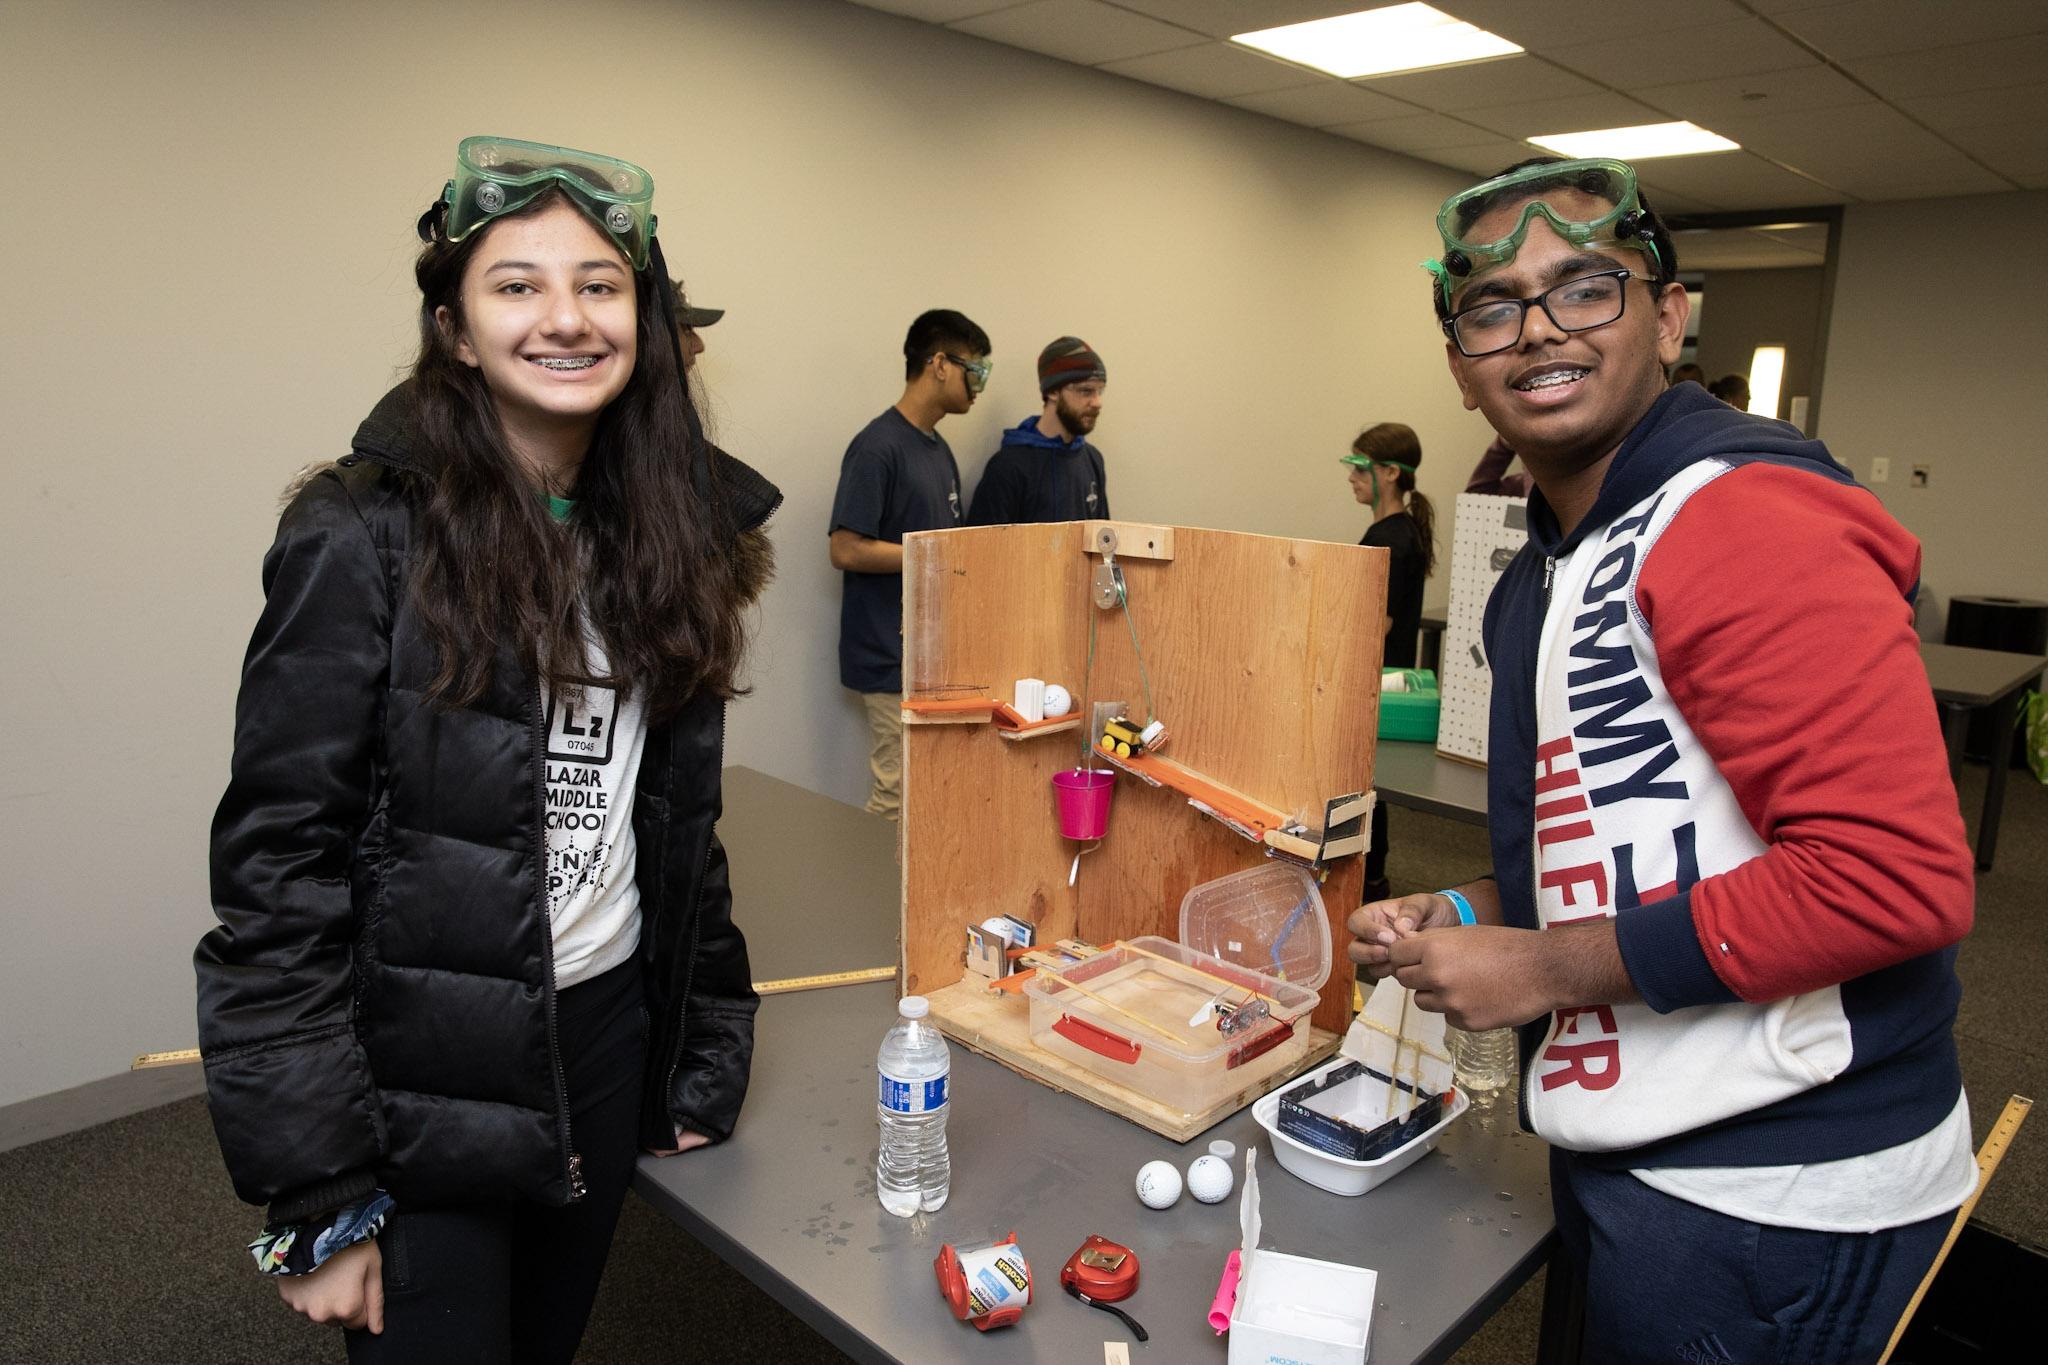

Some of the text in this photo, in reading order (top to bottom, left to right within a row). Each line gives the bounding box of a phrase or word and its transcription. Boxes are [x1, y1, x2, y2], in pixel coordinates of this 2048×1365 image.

[1567, 490, 1689, 808] TOMMY
[567, 740, 595, 752] 07045
[546, 765, 602, 788] LAZAR
[545, 787, 607, 810] MIDDLE
[546, 811, 607, 831] CHOO
[1535, 735, 1621, 1092] HILFER
[997, 1259, 1026, 1289] Scotch
